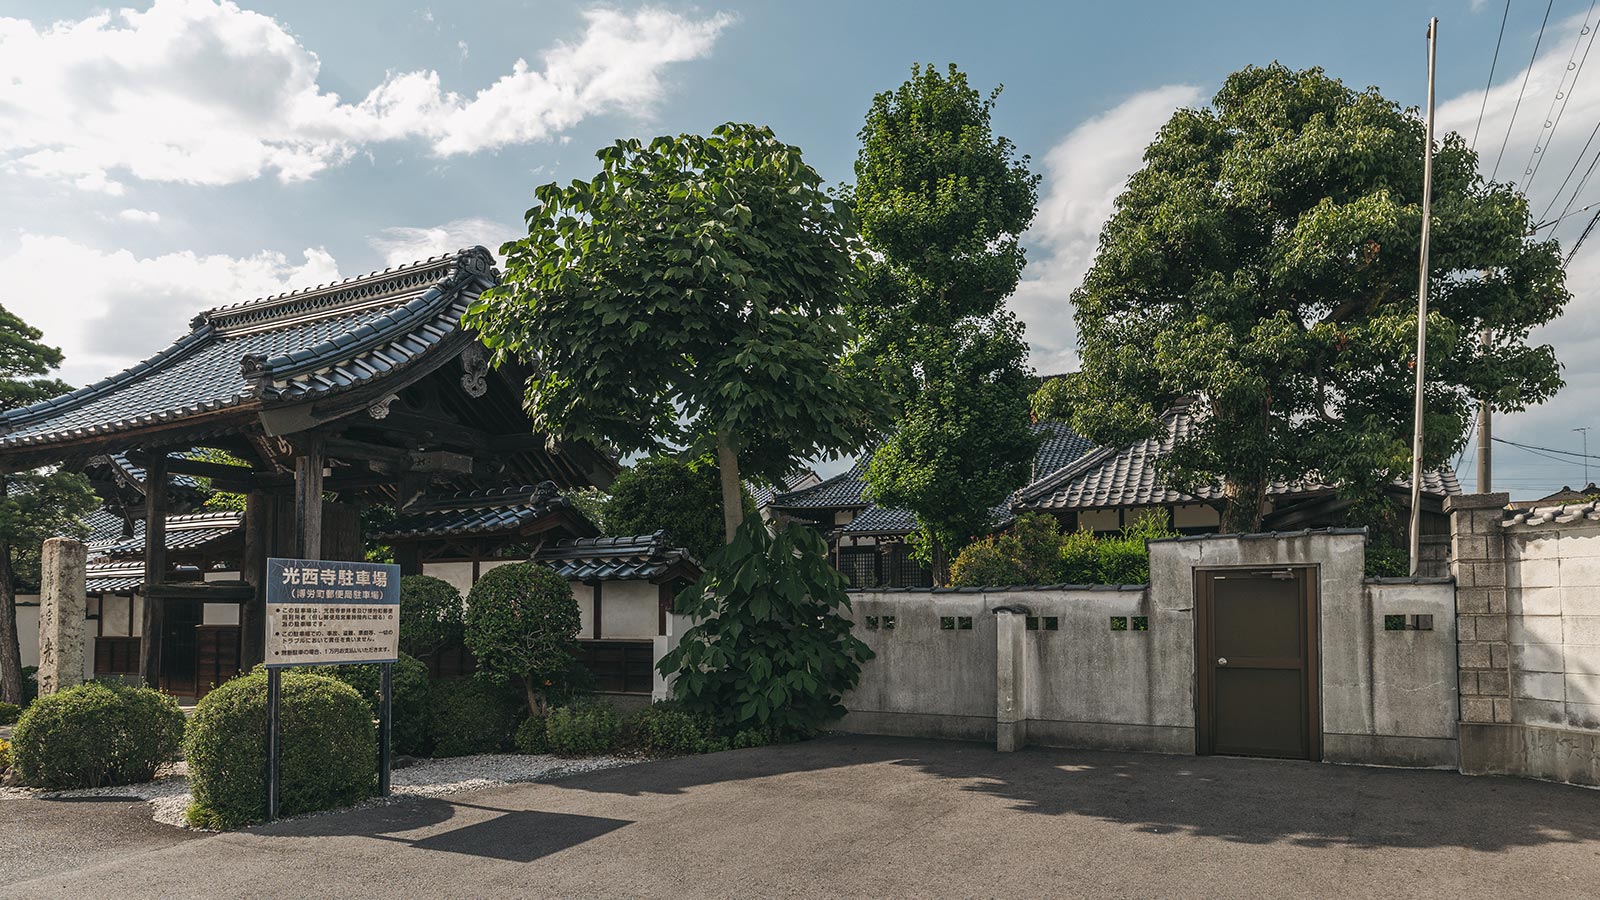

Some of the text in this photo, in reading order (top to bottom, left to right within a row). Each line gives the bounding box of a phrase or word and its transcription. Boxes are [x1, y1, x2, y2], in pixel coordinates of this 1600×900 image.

[282, 567, 388, 588] 光西寺駐車場
